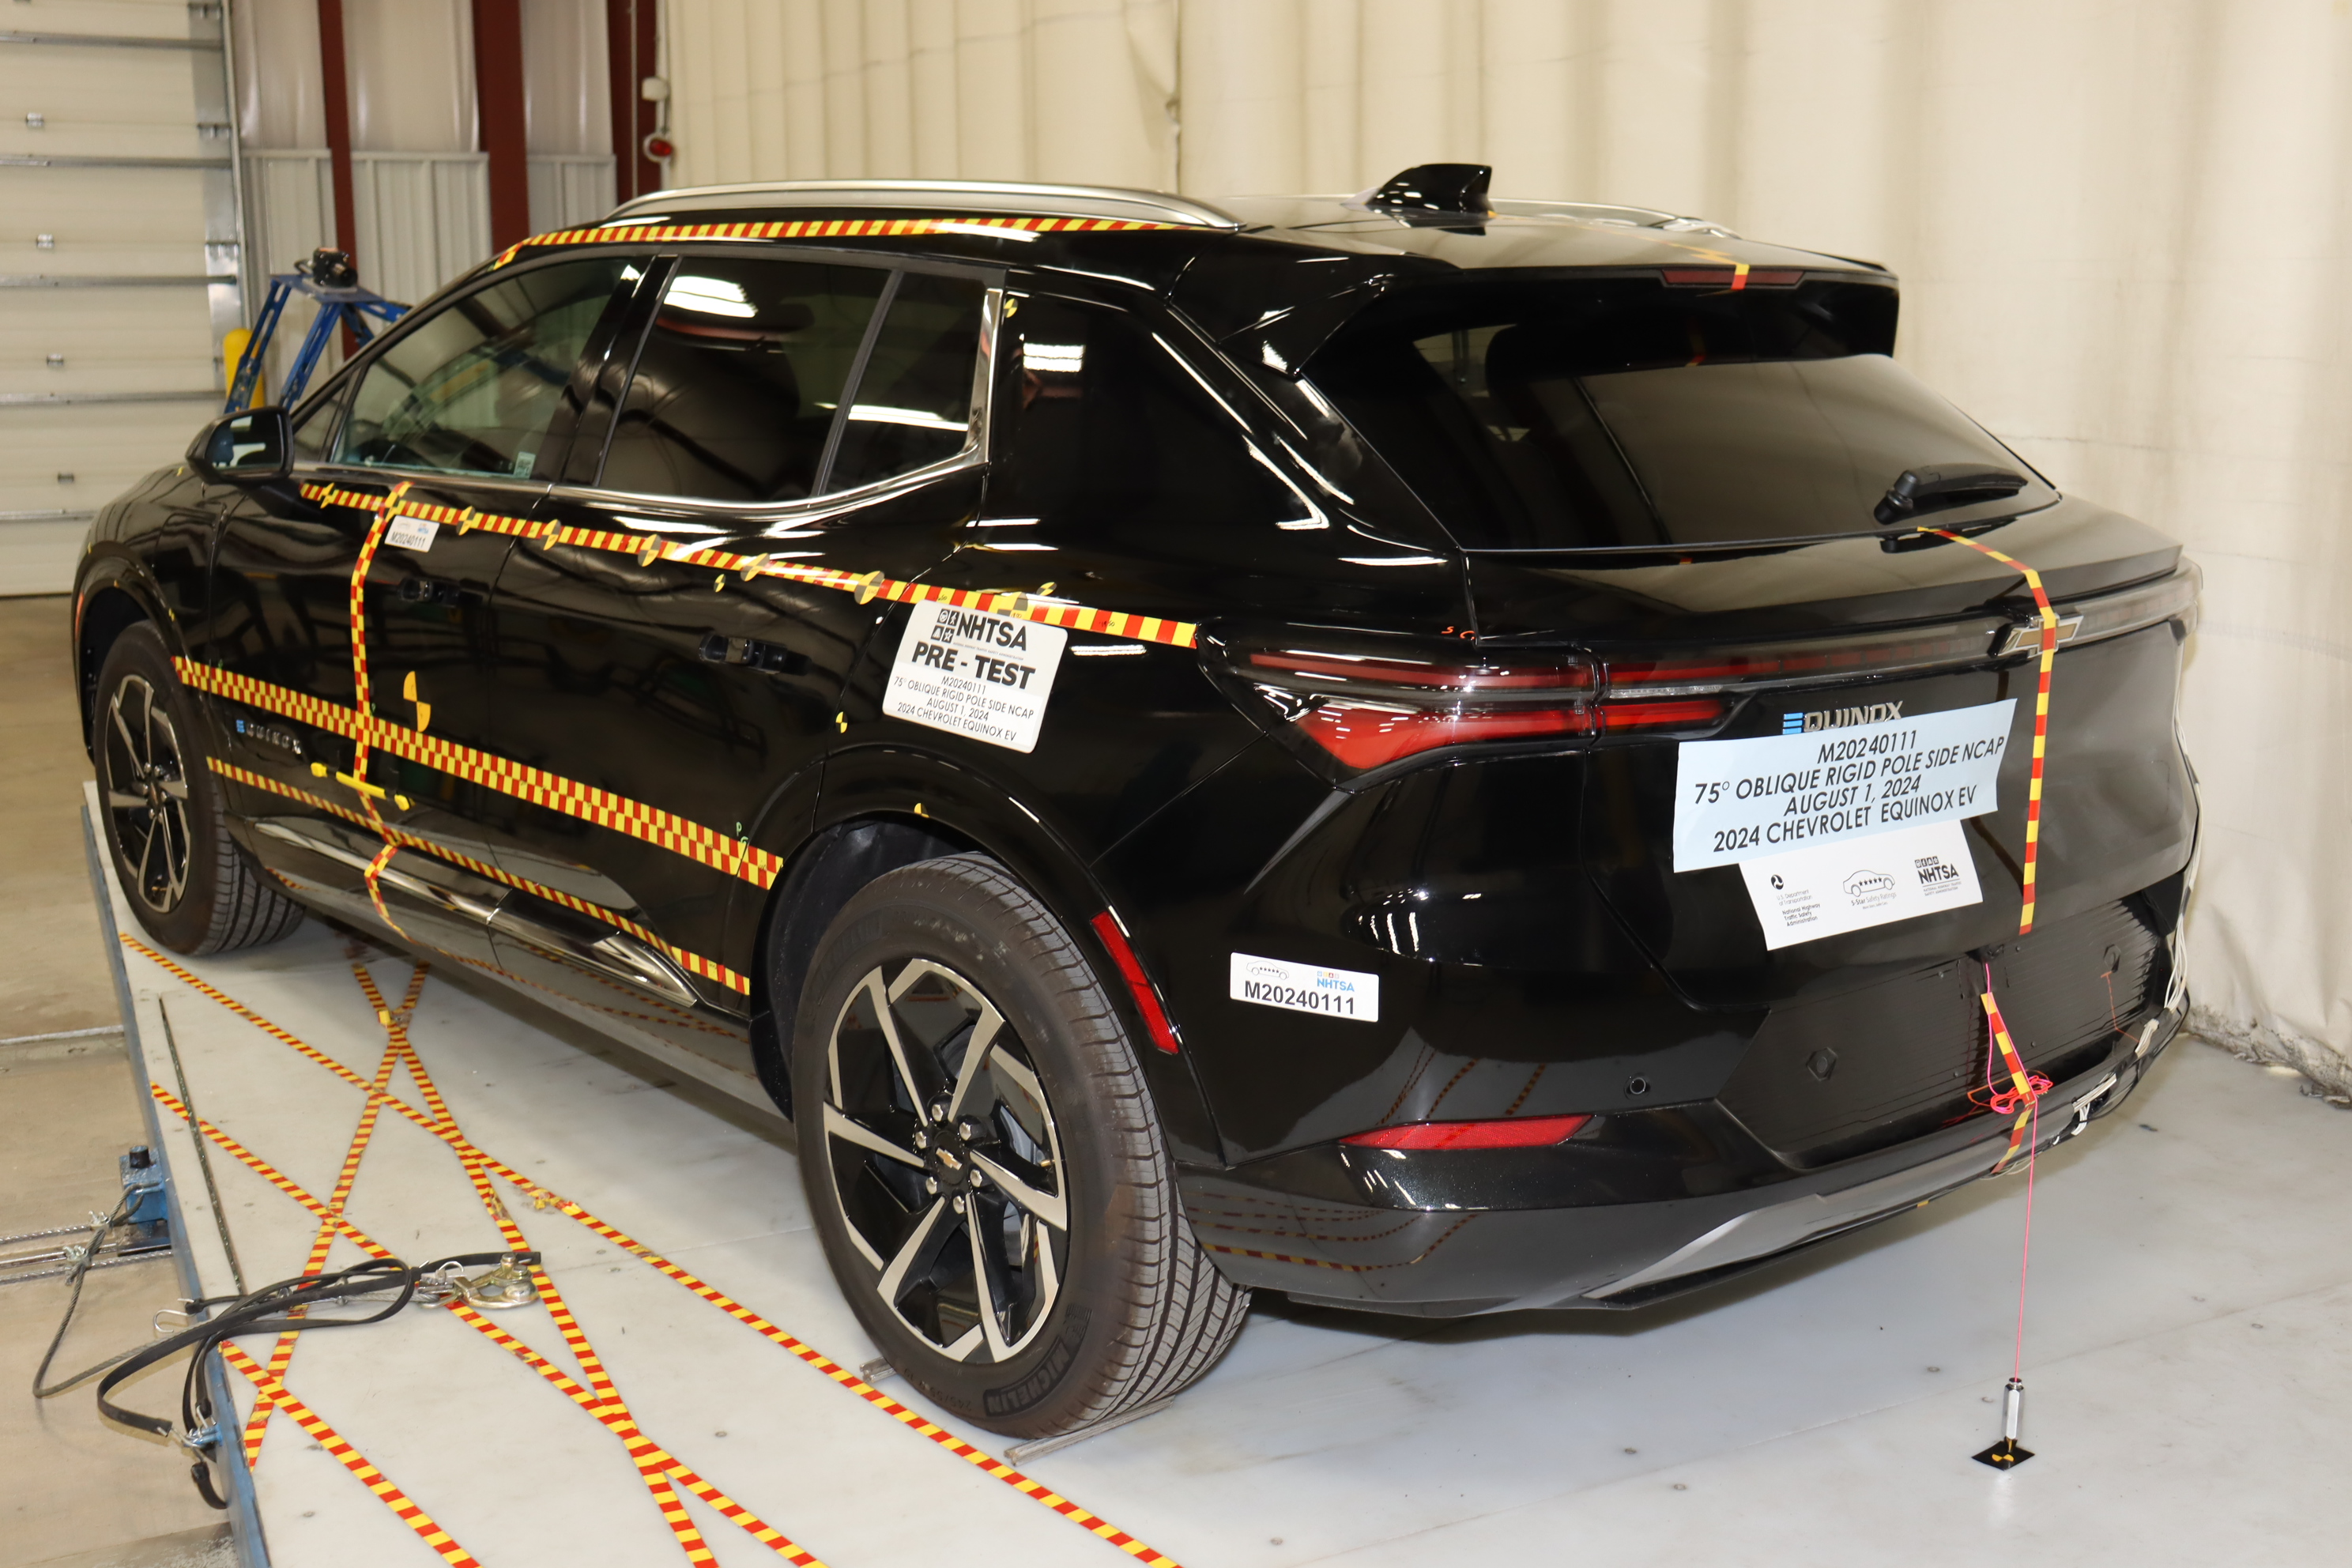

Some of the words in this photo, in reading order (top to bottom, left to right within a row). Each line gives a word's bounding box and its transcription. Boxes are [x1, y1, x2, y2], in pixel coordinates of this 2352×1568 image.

[956, 612, 1027, 651] NHTSA
[911, 641, 959, 672] PRE
[974, 654, 1036, 690] TEST
[907, 680, 941, 696] OBLIQUE
[941, 688, 964, 702] RIGID
[966, 694, 987, 707] POLE
[988, 699, 1007, 713] SIDE
[1008, 704, 1034, 719] NCAP
[941, 675, 986, 695] M20240111
[897, 702, 915, 715] 2024
[917, 707, 962, 727] CHEVROLET
[963, 718, 1003, 738] EQUINOX
[1004, 729, 1016, 741] EV
[926, 697, 959, 714] AUGUST
[969, 707, 989, 722] 2024
[1782, 700, 1903, 735] EQUINOX
[1816, 729, 1917, 764] M20240111
[1736, 768, 1820, 800] OBLIQUE
[1826, 760, 1876, 787] RIGID
[1881, 751, 1924, 778] POLE
[1925, 744, 1959, 770] SIDE
[1961, 736, 2006, 763] NCAP
[1783, 786, 1858, 817] AUGUST
[1881, 774, 1923, 801] 2024
[1713, 824, 1760, 853] 2024
[1766, 805, 1871, 844] CHEVROLET
[1880, 790, 1954, 824] EQUINOX
[1958, 783, 1977, 807] EV
[1917, 863, 1959, 884] NHTSA
[1782, 906, 1801, 915] National
[1784, 895, 1812, 905] Transportation
[1785, 889, 1809, 899] Department
[1866, 895, 1880, 903] Safety
[1787, 916, 1818, 927] Administration
[1245, 980, 1354, 1015] M20240111
[1317, 978, 1355, 993] NHTSA
[987, 1340, 1070, 1414] MICHELIN
